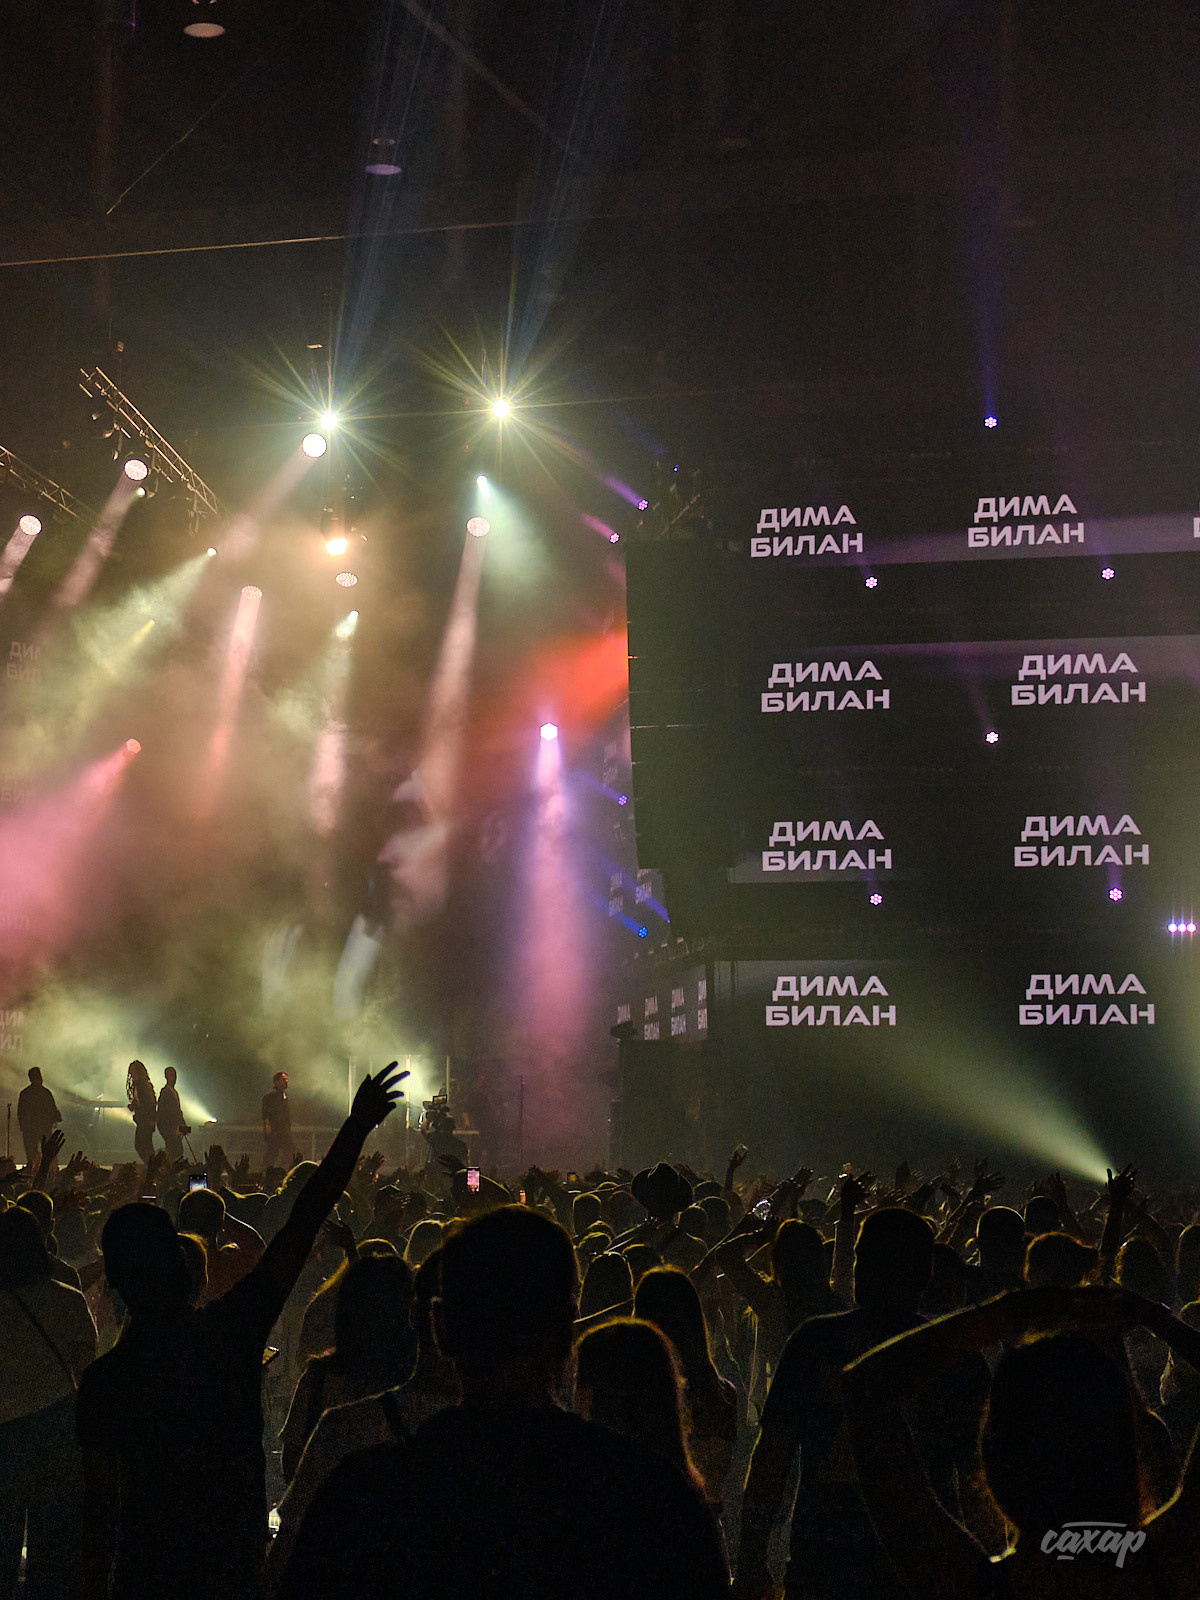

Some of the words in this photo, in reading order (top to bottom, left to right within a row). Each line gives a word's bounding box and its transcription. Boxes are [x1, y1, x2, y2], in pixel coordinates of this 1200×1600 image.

[757, 505, 856, 533] ДИМА
[974, 495, 1077, 523] ДИМА
[751, 533, 863, 557] БИЛАН
[968, 523, 1084, 547] БИЛАН
[768, 661, 882, 688] ДИМА
[1019, 653, 1138, 680] ДИМА
[762, 689, 890, 712] БИЛАН
[1012, 682, 1146, 706] БИЛАН
[769, 820, 884, 846] ДИМА
[1021, 815, 1141, 842] ДИМА
[763, 849, 892, 871] БИЛАН
[1015, 845, 1149, 867] БИЛАН
[773, 976, 888, 1001] ДИМА
[1026, 974, 1146, 999] ДИМА
[766, 1006, 896, 1026] БИЛАН
[1019, 1004, 1155, 1025] БИЛАН
